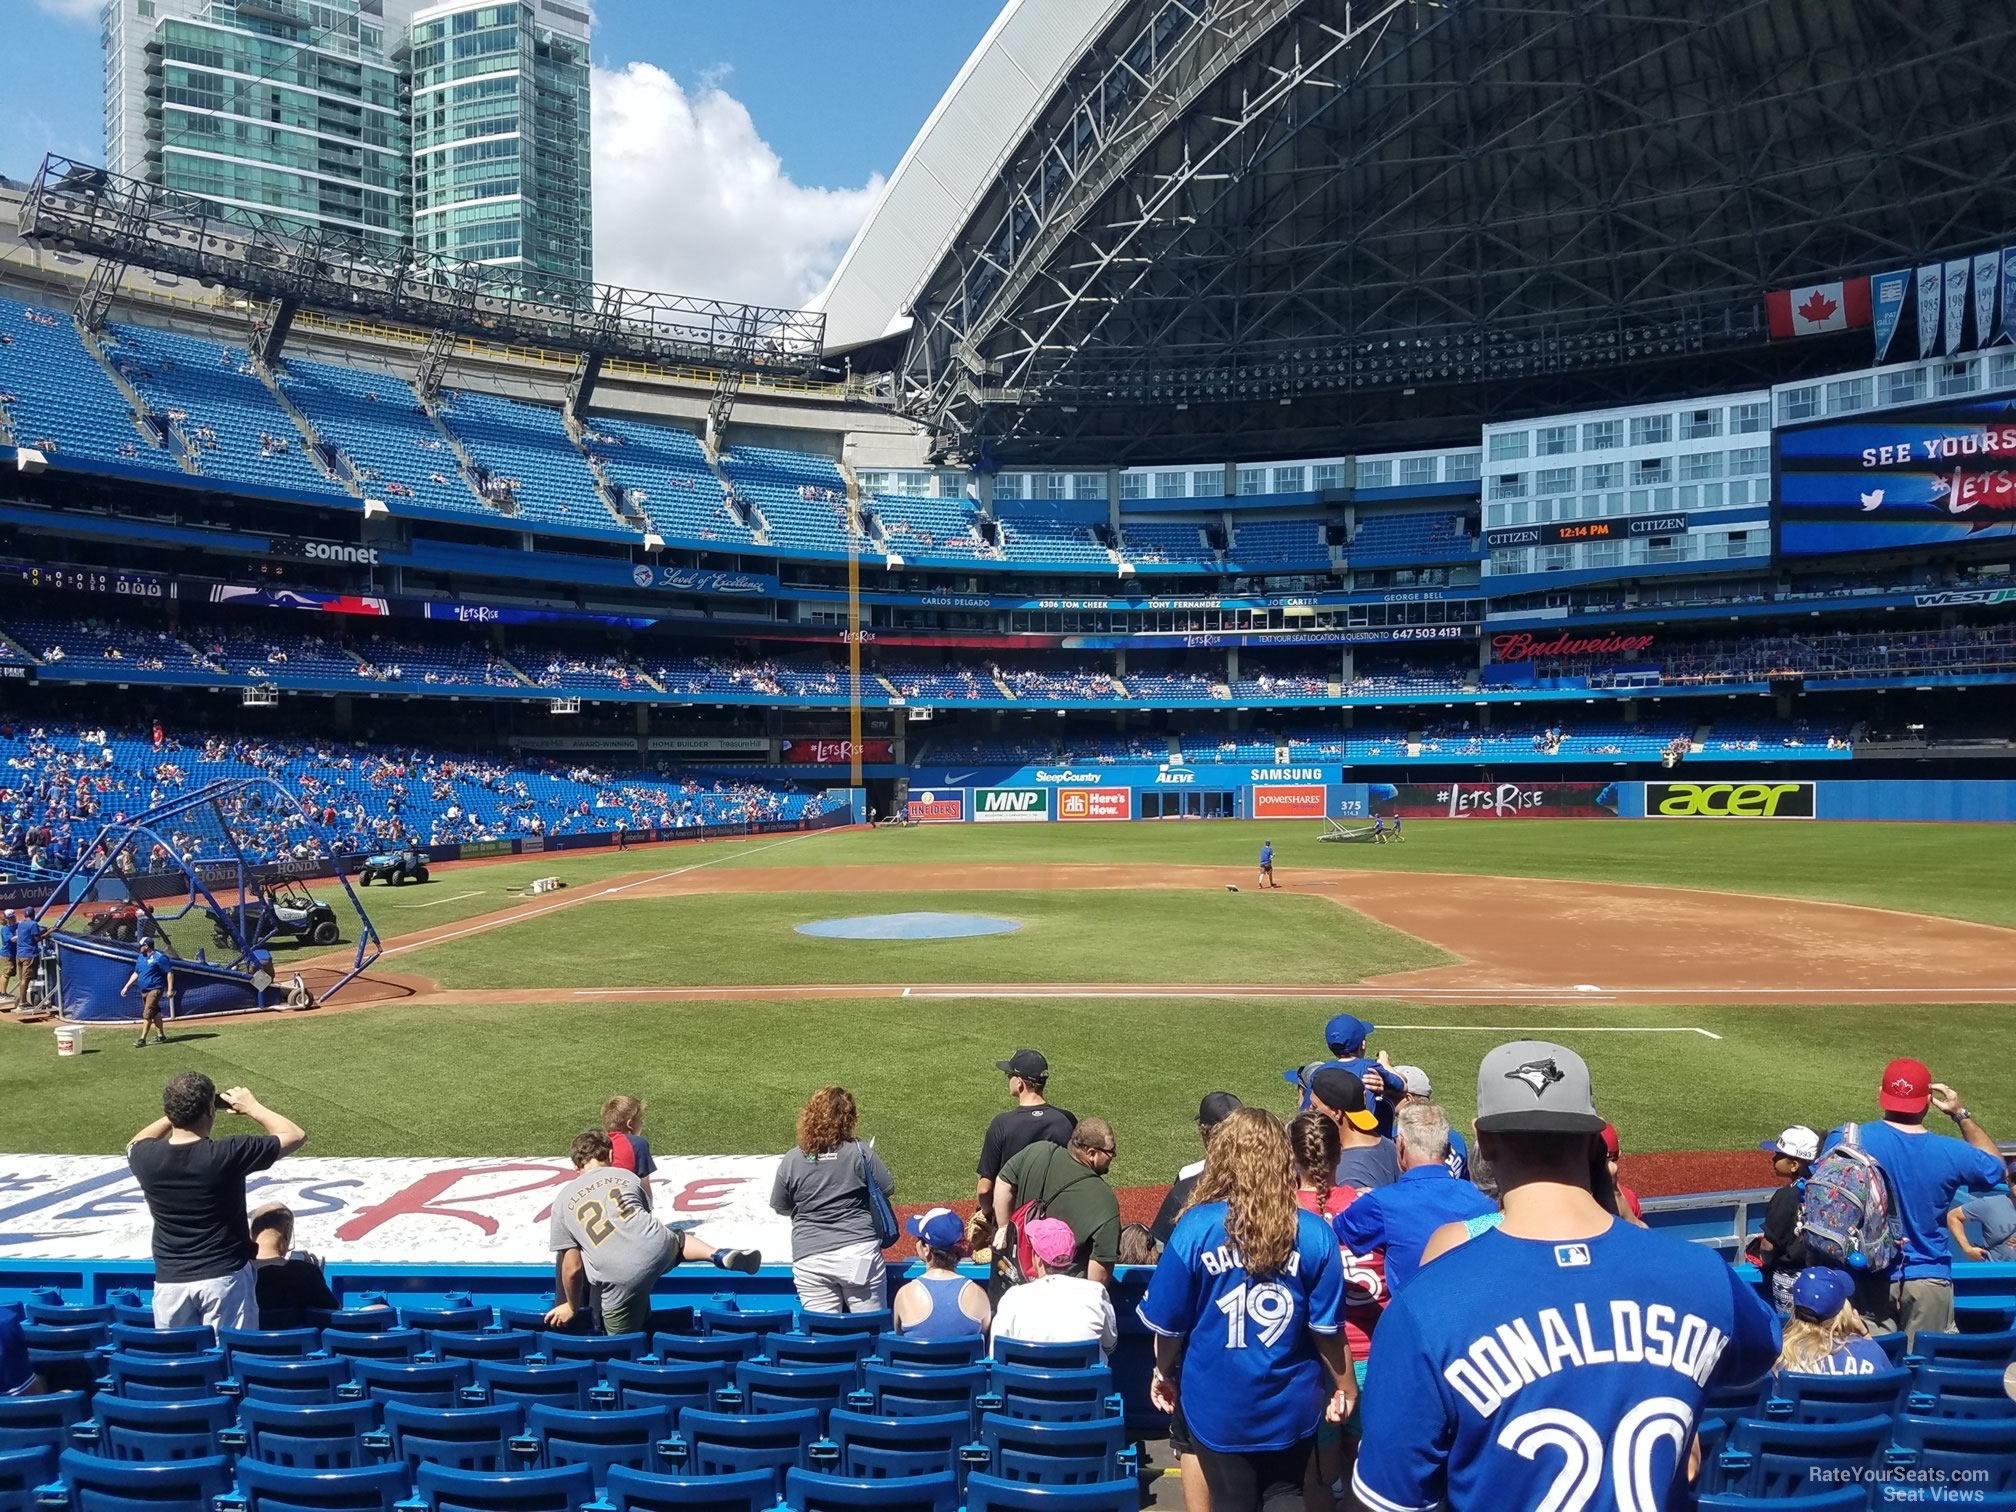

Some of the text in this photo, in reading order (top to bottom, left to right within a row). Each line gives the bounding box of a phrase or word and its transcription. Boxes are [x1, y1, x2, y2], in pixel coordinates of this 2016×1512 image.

[1920, 297, 1938, 313] 1985
[1948, 294, 1965, 308] 198
[1862, 429, 2016, 467] SEE YOURS
[1560, 524, 1609, 538] 12:14 PM
[1632, 518, 1685, 532] CITIZEN
[1488, 531, 1539, 545] CITIZEN
[305, 543, 378, 565] sonnet
[658, 567, 765, 593] Level of Excellence
[921, 597, 991, 607] CARLOS DELGADO
[1268, 598, 1318, 607] JOE CARTER
[1384, 592, 1443, 602] GEORGE BELL
[1038, 600, 1108, 609] 4306 TOM CHEEK
[1148, 600, 1221, 609] TONY FERNANDEZ
[1259, 627, 1461, 643] TEXT YOUR SEAT LOCATION & QUESTION TO 647 503 4131
[1492, 631, 1653, 660] Budweiser
[1251, 768, 1322, 780] SAMSUNG
[985, 792, 1038, 811] MNP
[1089, 793, 1126, 804] Here's
[1660, 784, 1800, 816] acer
[1089, 804, 1119, 815] How.
[1341, 801, 1361, 811] 375
[277, 861, 321, 875] HONDA
[20, 886, 56, 899] VorMa
[1796, 1149, 1812, 1158] 1993
[567, 1177, 631, 1211] CLEMENTE
[576, 1186, 640, 1248] 21
[1215, 1281, 1295, 1348] 19
[1443, 1300, 1731, 1419] DONALDSON
[1497, 1397, 1694, 1512] 20
